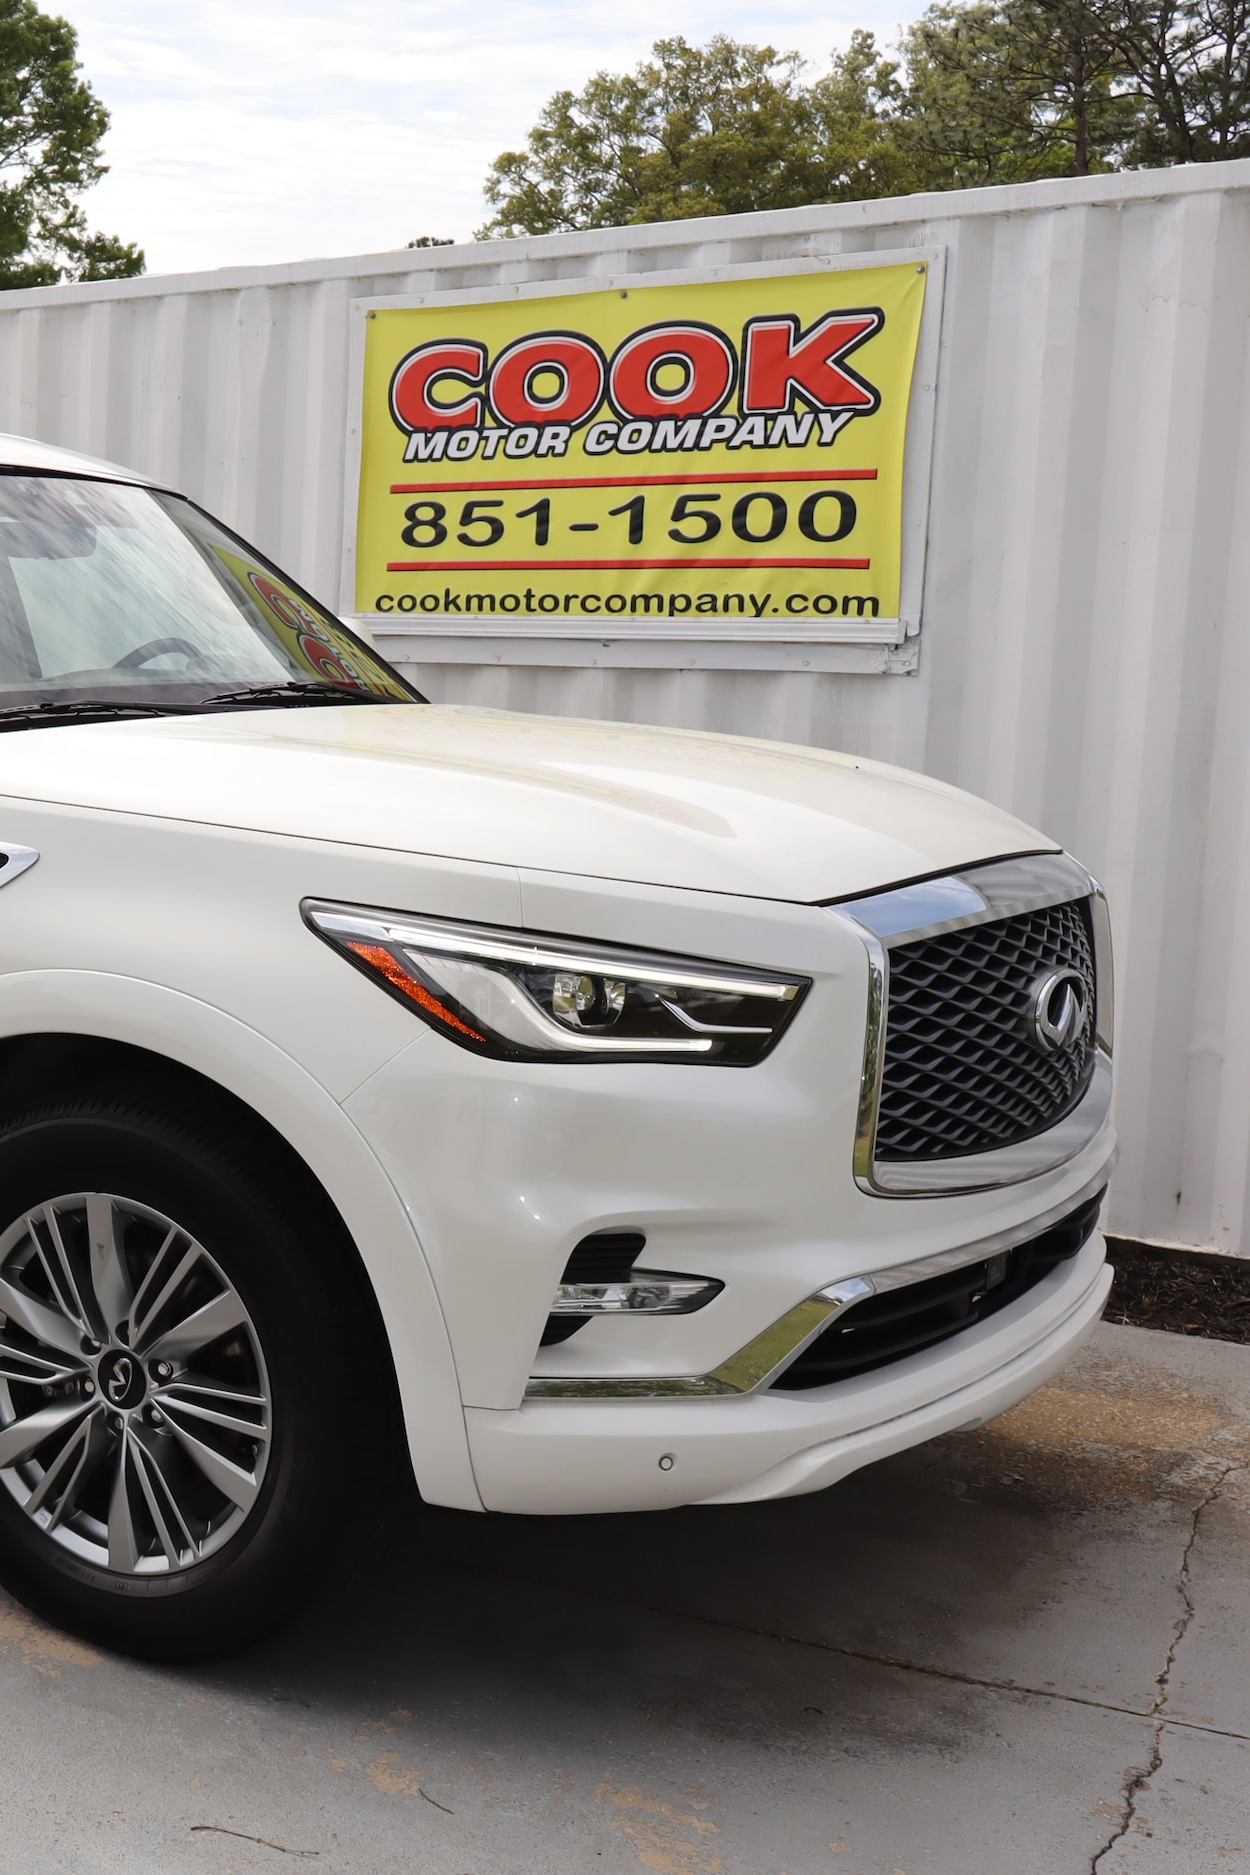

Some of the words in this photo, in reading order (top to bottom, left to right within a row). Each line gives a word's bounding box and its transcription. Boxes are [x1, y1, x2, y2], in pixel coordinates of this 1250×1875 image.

[388, 306, 885, 433] COOK
[403, 424, 570, 463] MOTOR
[584, 411, 854, 455] COMPANY
[400, 490, 857, 548] 851-1500
[375, 587, 880, 618] cookmotorcompany.com
